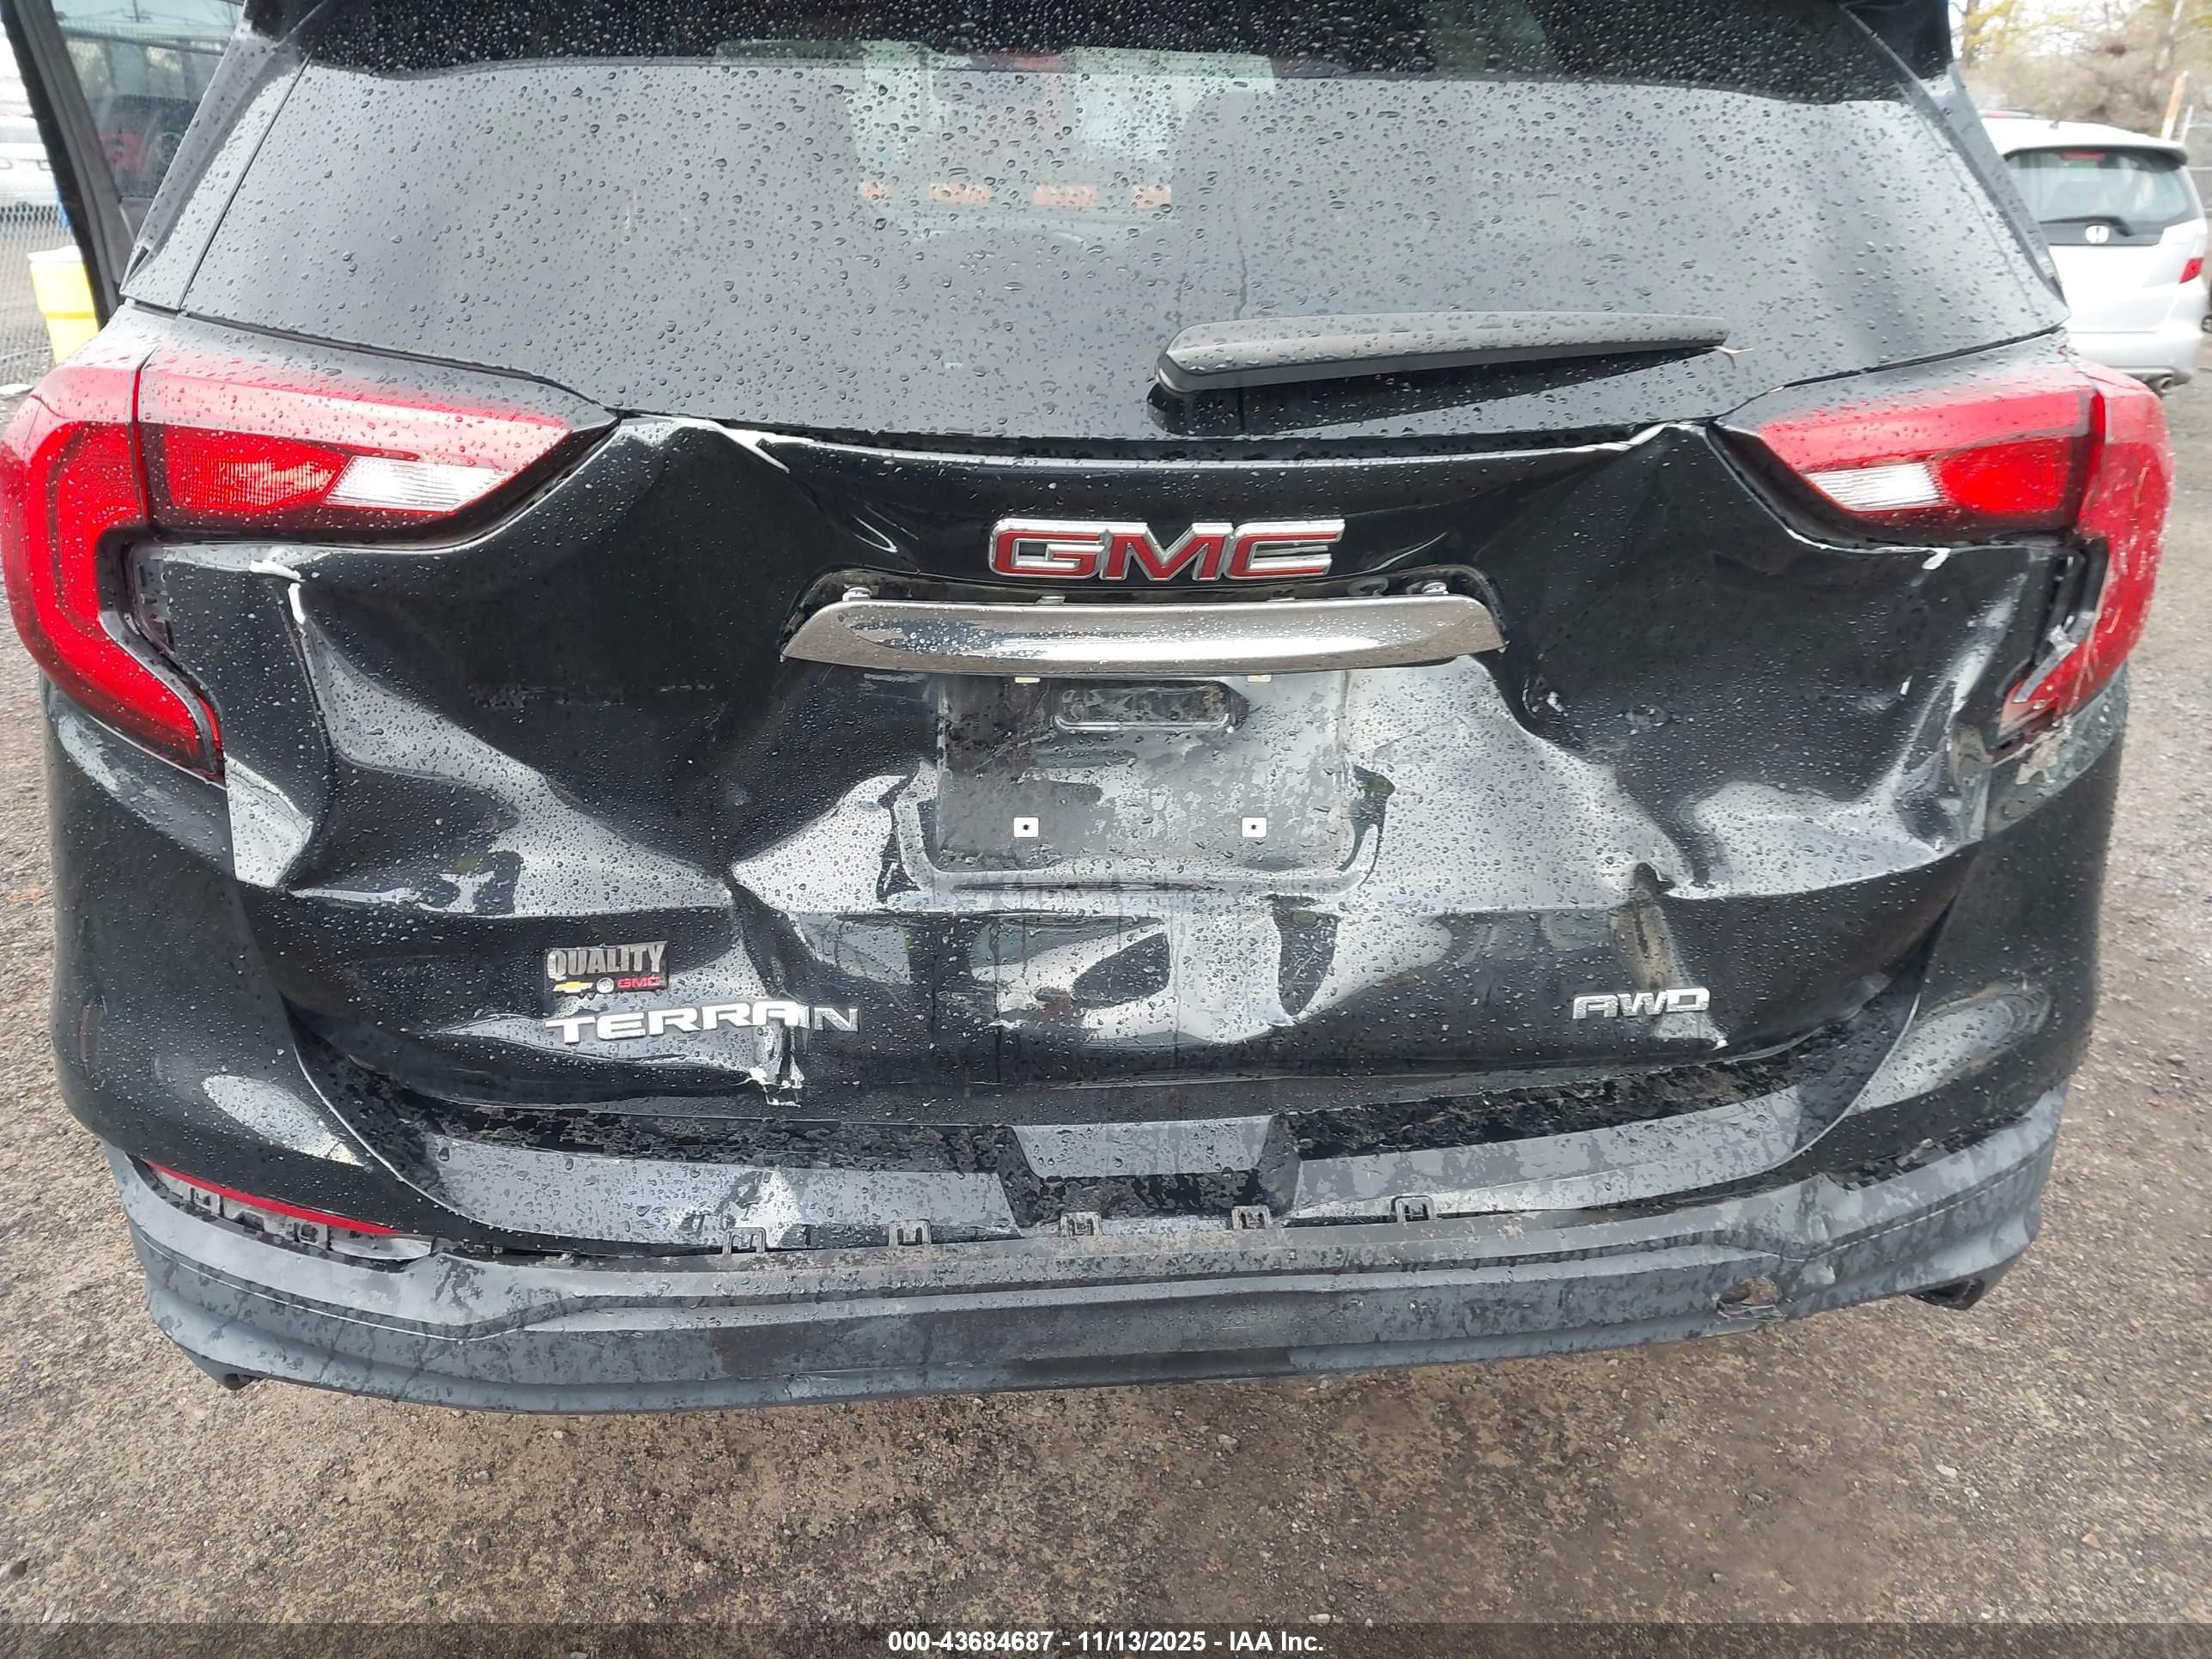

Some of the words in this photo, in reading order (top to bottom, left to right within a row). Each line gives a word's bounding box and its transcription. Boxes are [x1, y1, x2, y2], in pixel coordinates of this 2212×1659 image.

[988, 517, 1346, 581] GMC
[546, 941, 668, 981] QUALITY
[617, 975, 660, 989] GMC
[545, 1000, 859, 1044] TERRAIN
[1572, 987, 1711, 1020] AWD
